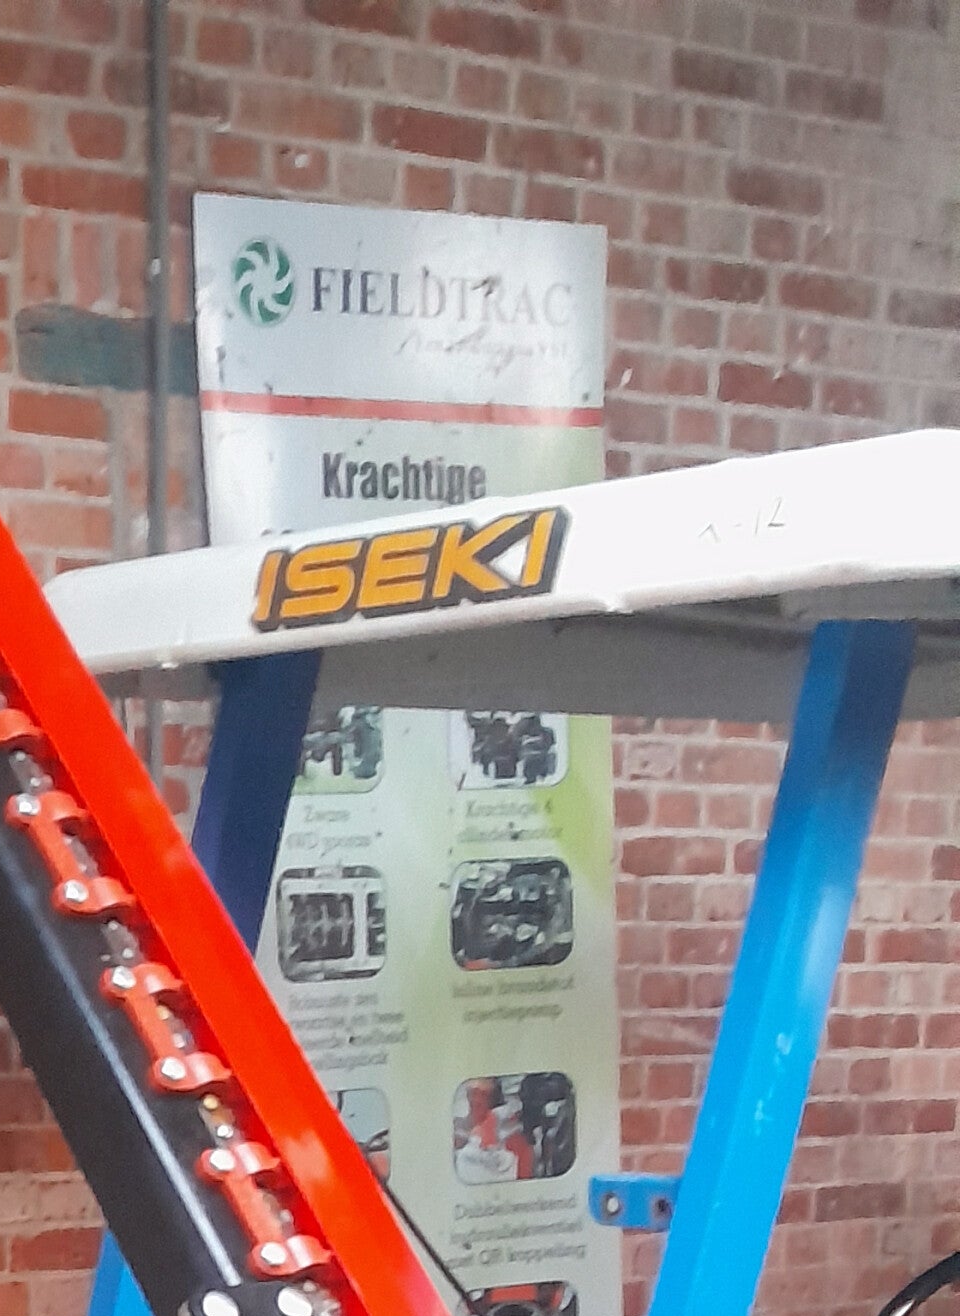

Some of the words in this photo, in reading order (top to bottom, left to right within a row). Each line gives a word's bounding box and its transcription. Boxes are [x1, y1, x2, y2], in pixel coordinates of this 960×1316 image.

[312, 265, 572, 327] FIELDTRAC
[323, 451, 487, 504] Krachtige
[252, 504, 572, 633] ISEKI
